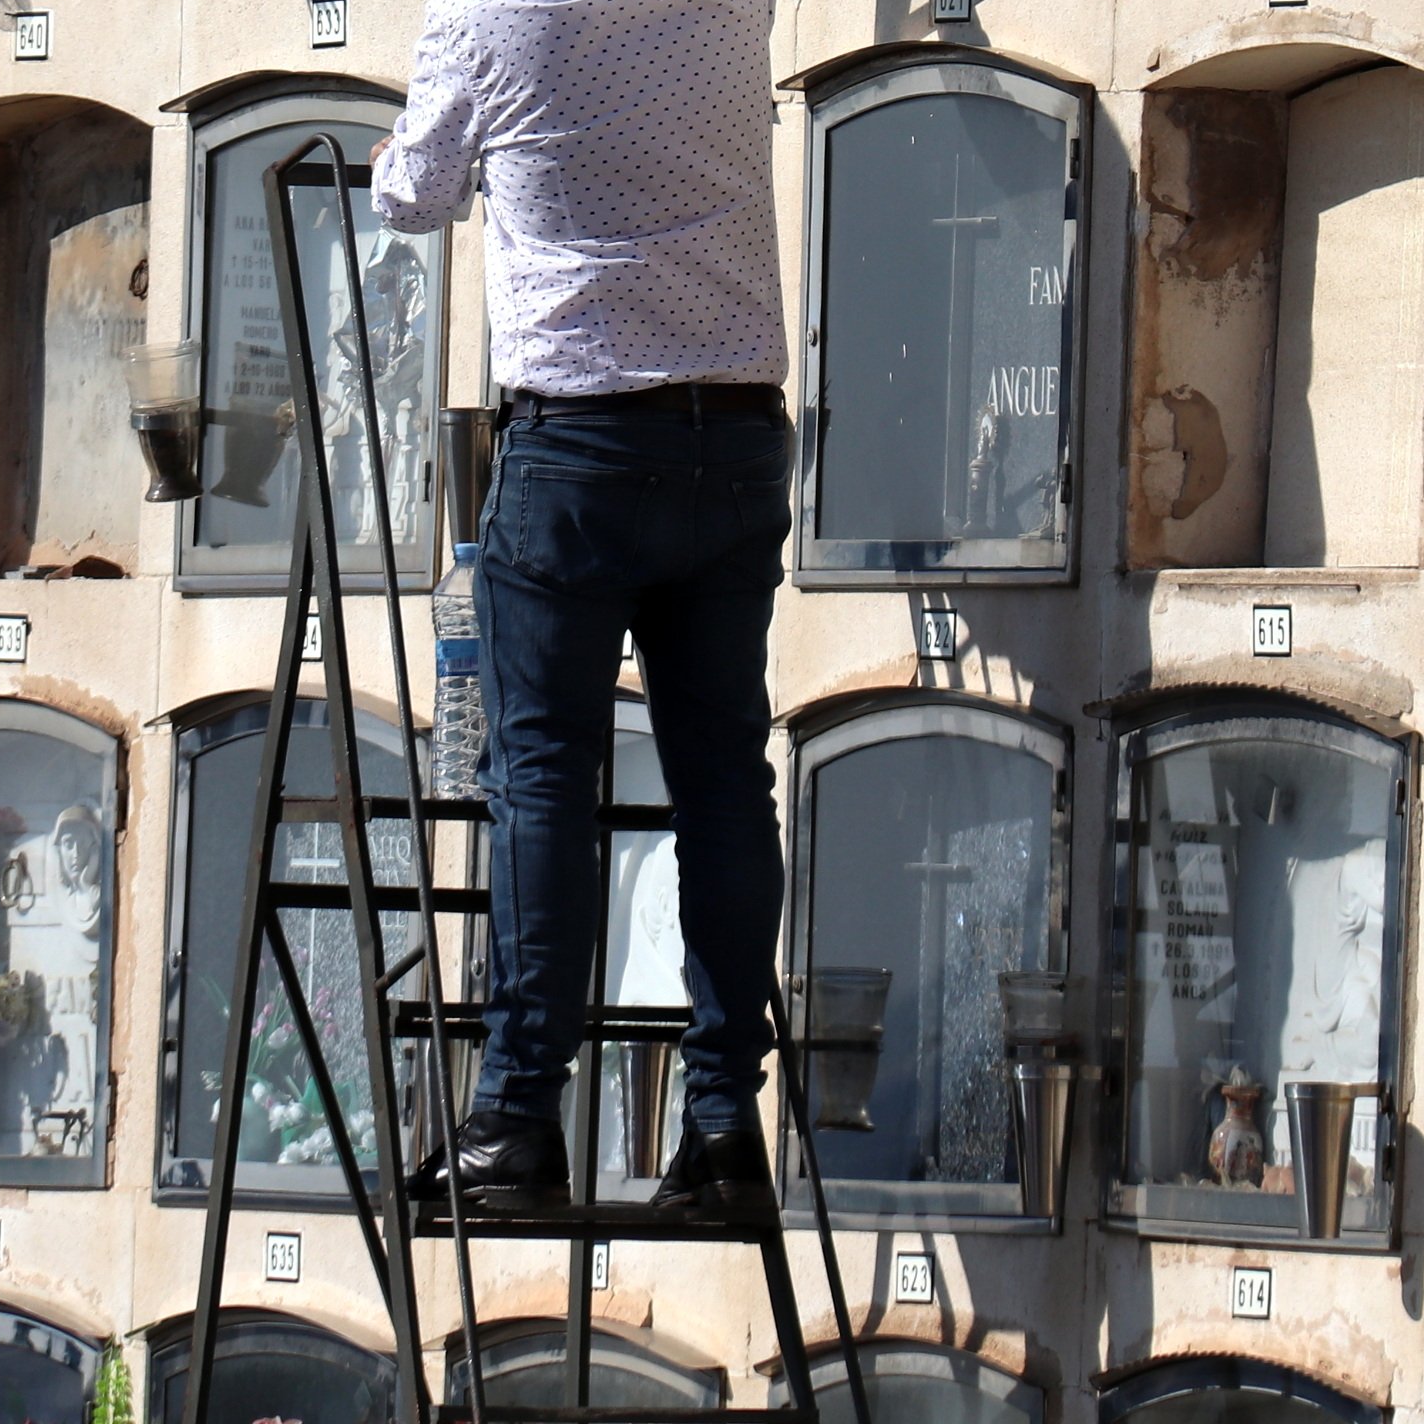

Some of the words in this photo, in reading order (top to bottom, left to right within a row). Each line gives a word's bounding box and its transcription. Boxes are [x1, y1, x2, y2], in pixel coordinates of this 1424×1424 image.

[19, 23, 43, 50] 640
[316, 8, 341, 36] 633
[925, 620, 951, 649] 622
[1258, 617, 1285, 646] 615
[270, 1243, 295, 1272] 635
[901, 1262, 928, 1293] 623
[1237, 1277, 1265, 1307] 614
